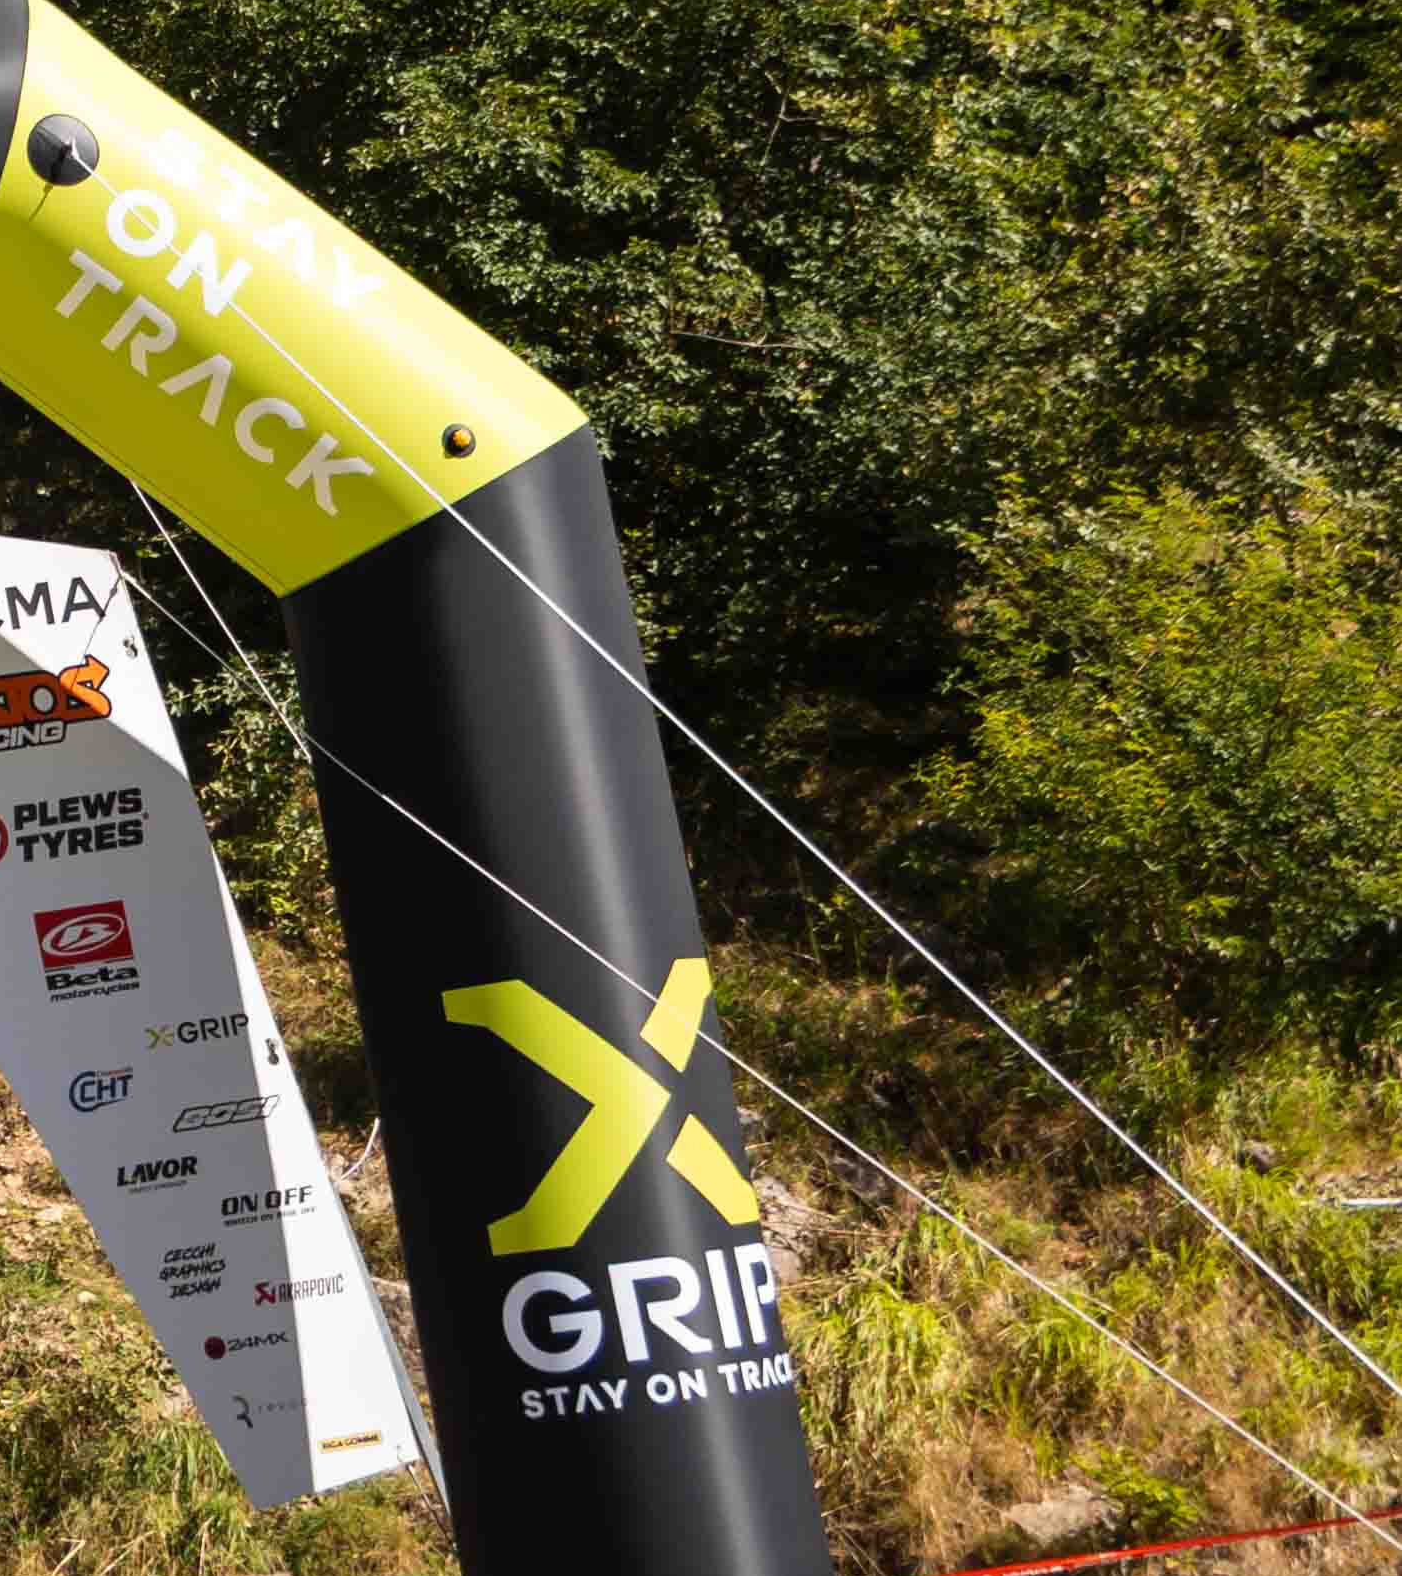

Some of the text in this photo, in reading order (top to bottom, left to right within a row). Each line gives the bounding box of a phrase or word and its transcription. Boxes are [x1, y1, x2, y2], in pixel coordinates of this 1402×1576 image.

[106, 189, 254, 318] ON
[54, 248, 374, 517] TRACK
[13, 788, 143, 831] PLEWS
[16, 819, 144, 862] TYRES
[45, 965, 138, 991] Beta
[50, 982, 140, 1003] motorcycles
[117, 1156, 198, 1187] LAVOR
[221, 1185, 312, 1216] ON OFF
[502, 1243, 776, 1373] GRIP
[521, 1352, 794, 1419] STAY ON TRAC
